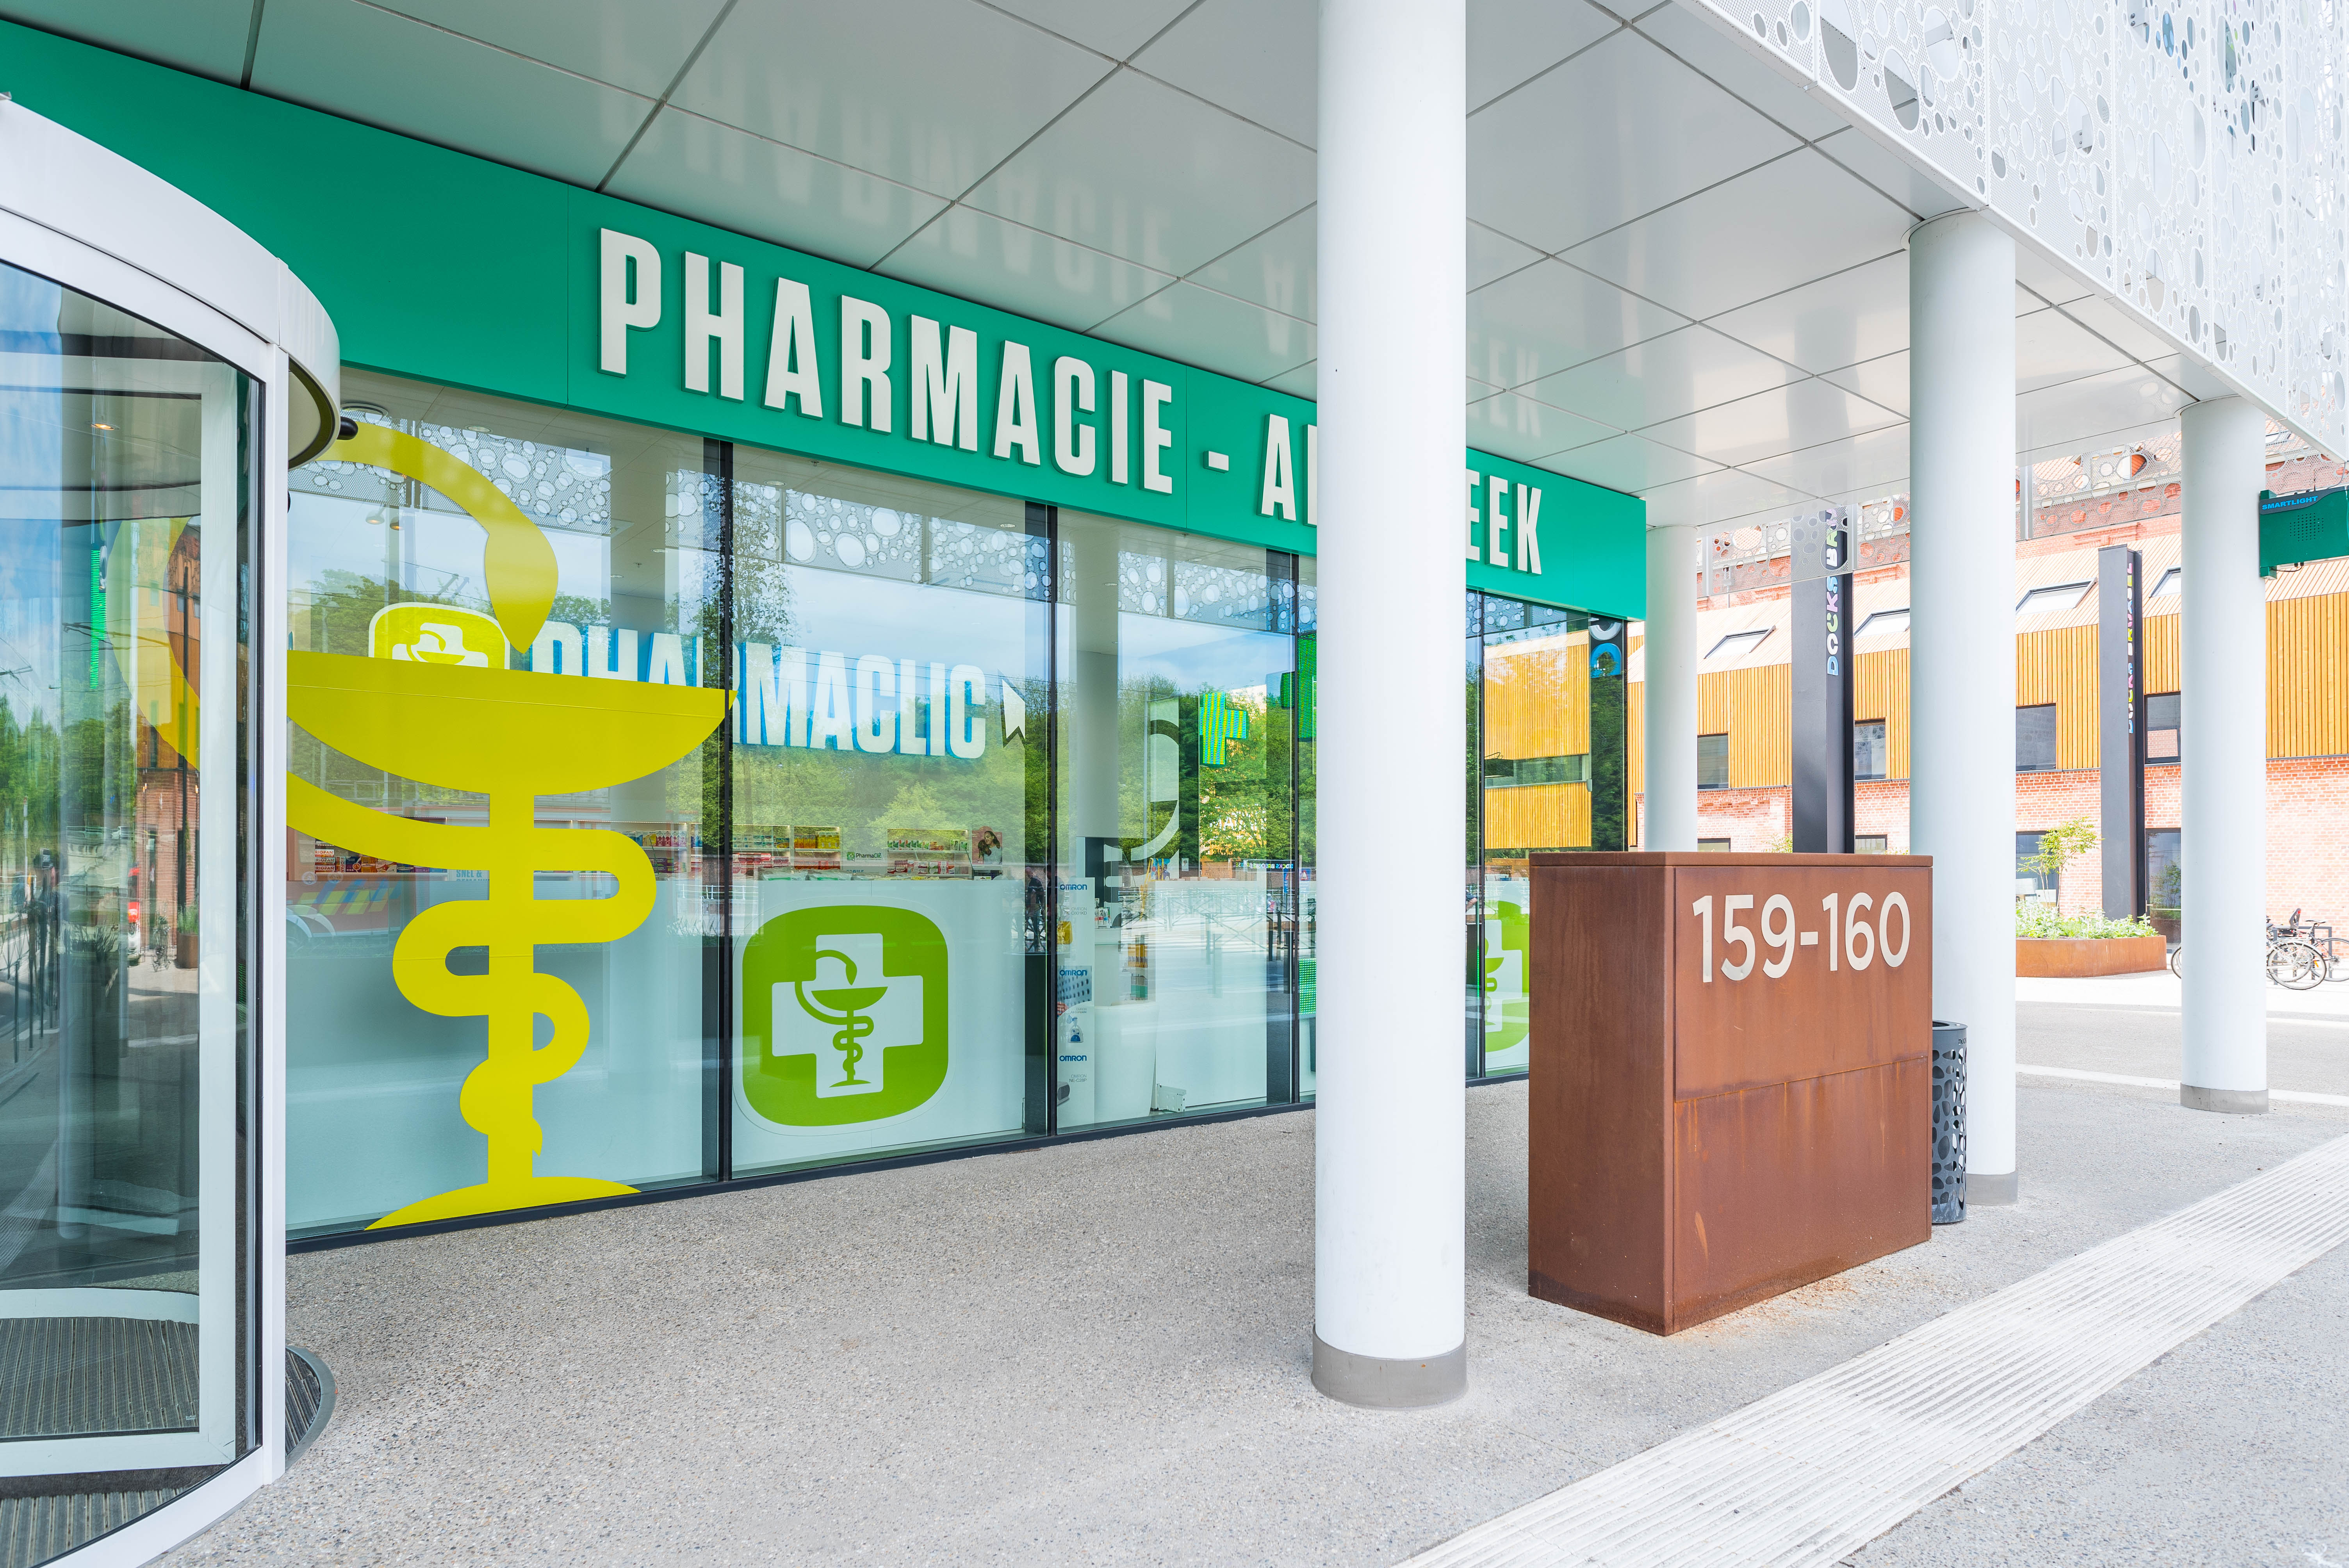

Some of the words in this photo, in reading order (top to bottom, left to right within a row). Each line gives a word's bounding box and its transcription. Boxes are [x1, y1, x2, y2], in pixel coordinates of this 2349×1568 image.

[599, 228, 1172, 495] PHARMACIE
[2262, 496, 2318, 510] SMARTLIGHT
[1826, 576, 1839, 676] DOCKS
[1692, 891, 1910, 983] 159-160
